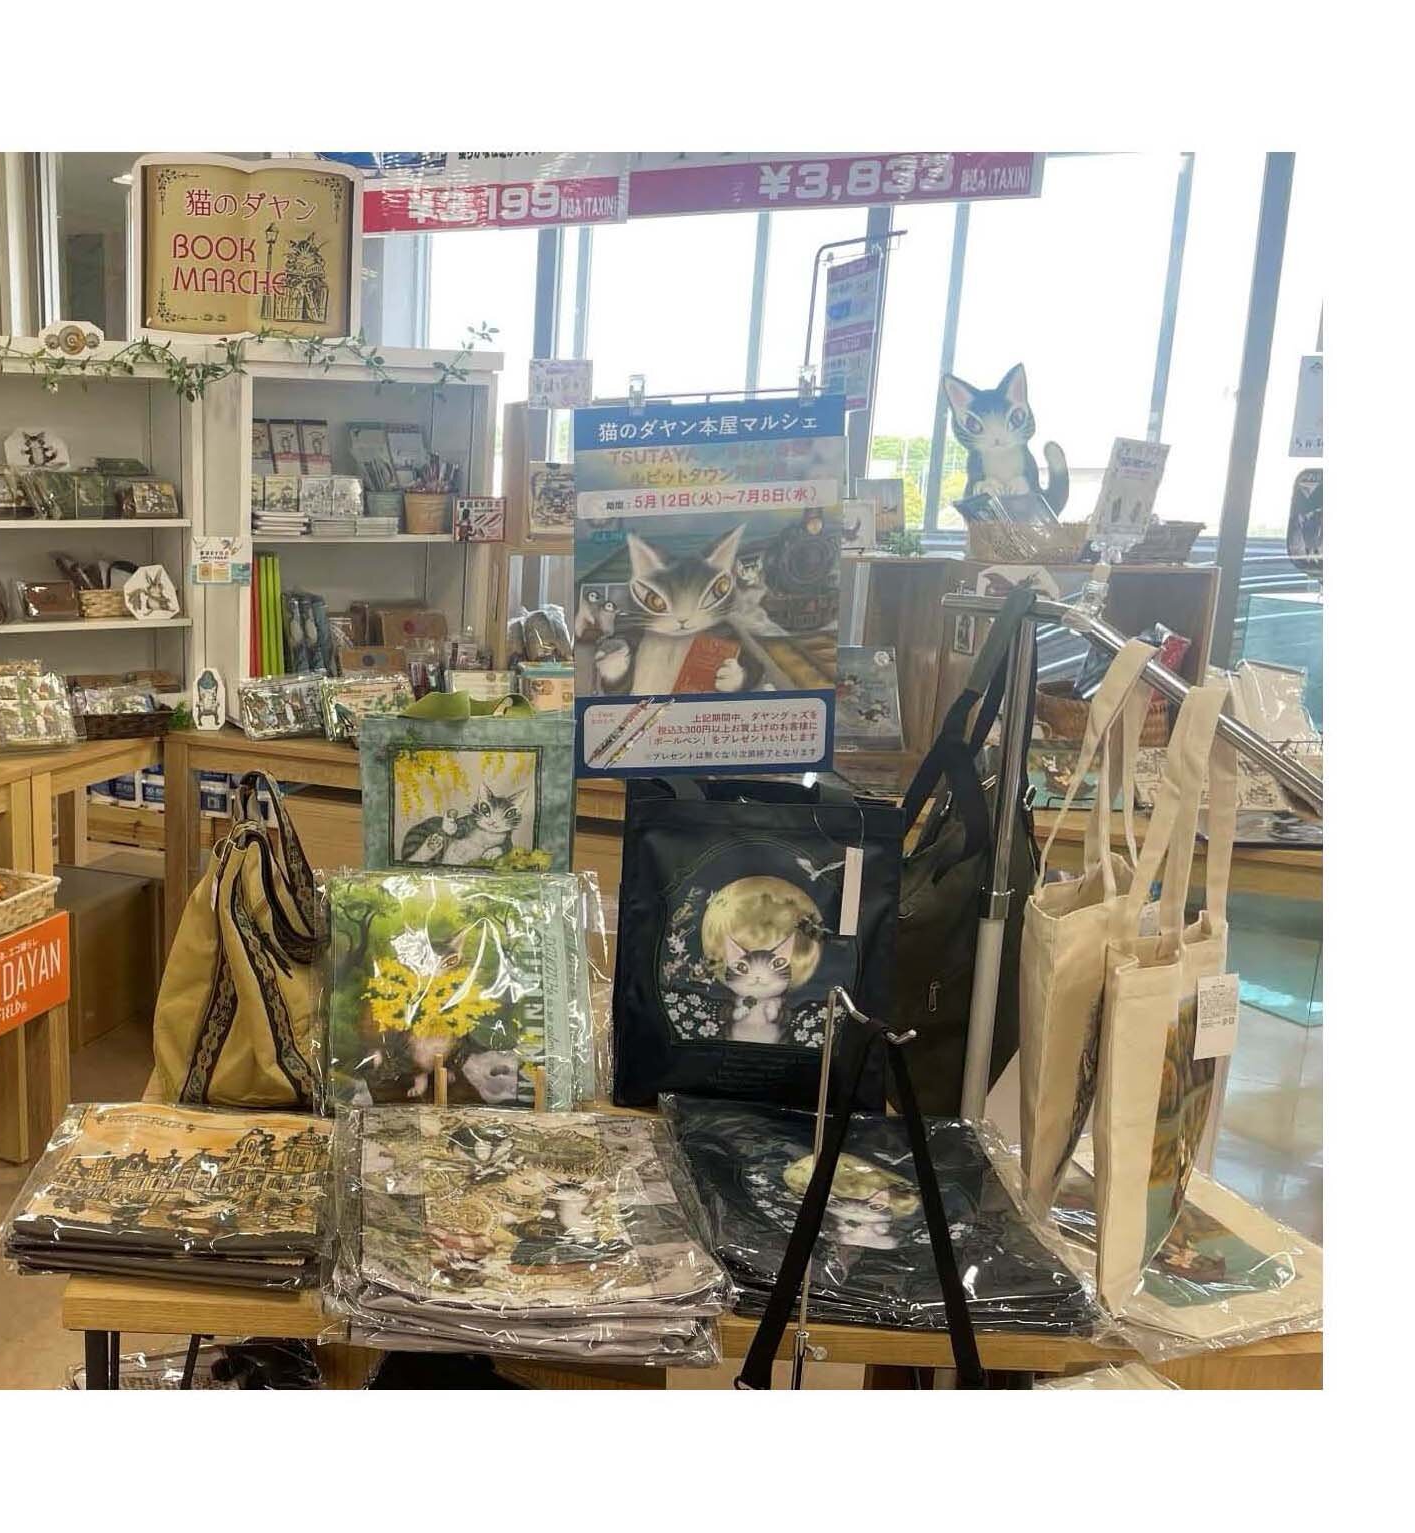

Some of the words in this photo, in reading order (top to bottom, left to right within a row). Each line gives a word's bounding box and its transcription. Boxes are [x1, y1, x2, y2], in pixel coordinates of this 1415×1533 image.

[186, 189, 317, 221] 猫のダヤン
[173, 234, 257, 262] BOOK
[598, 412, 818, 443] 猫のダヤン本屋マルシェ
[2, 938, 62, 1002] DAYAN
